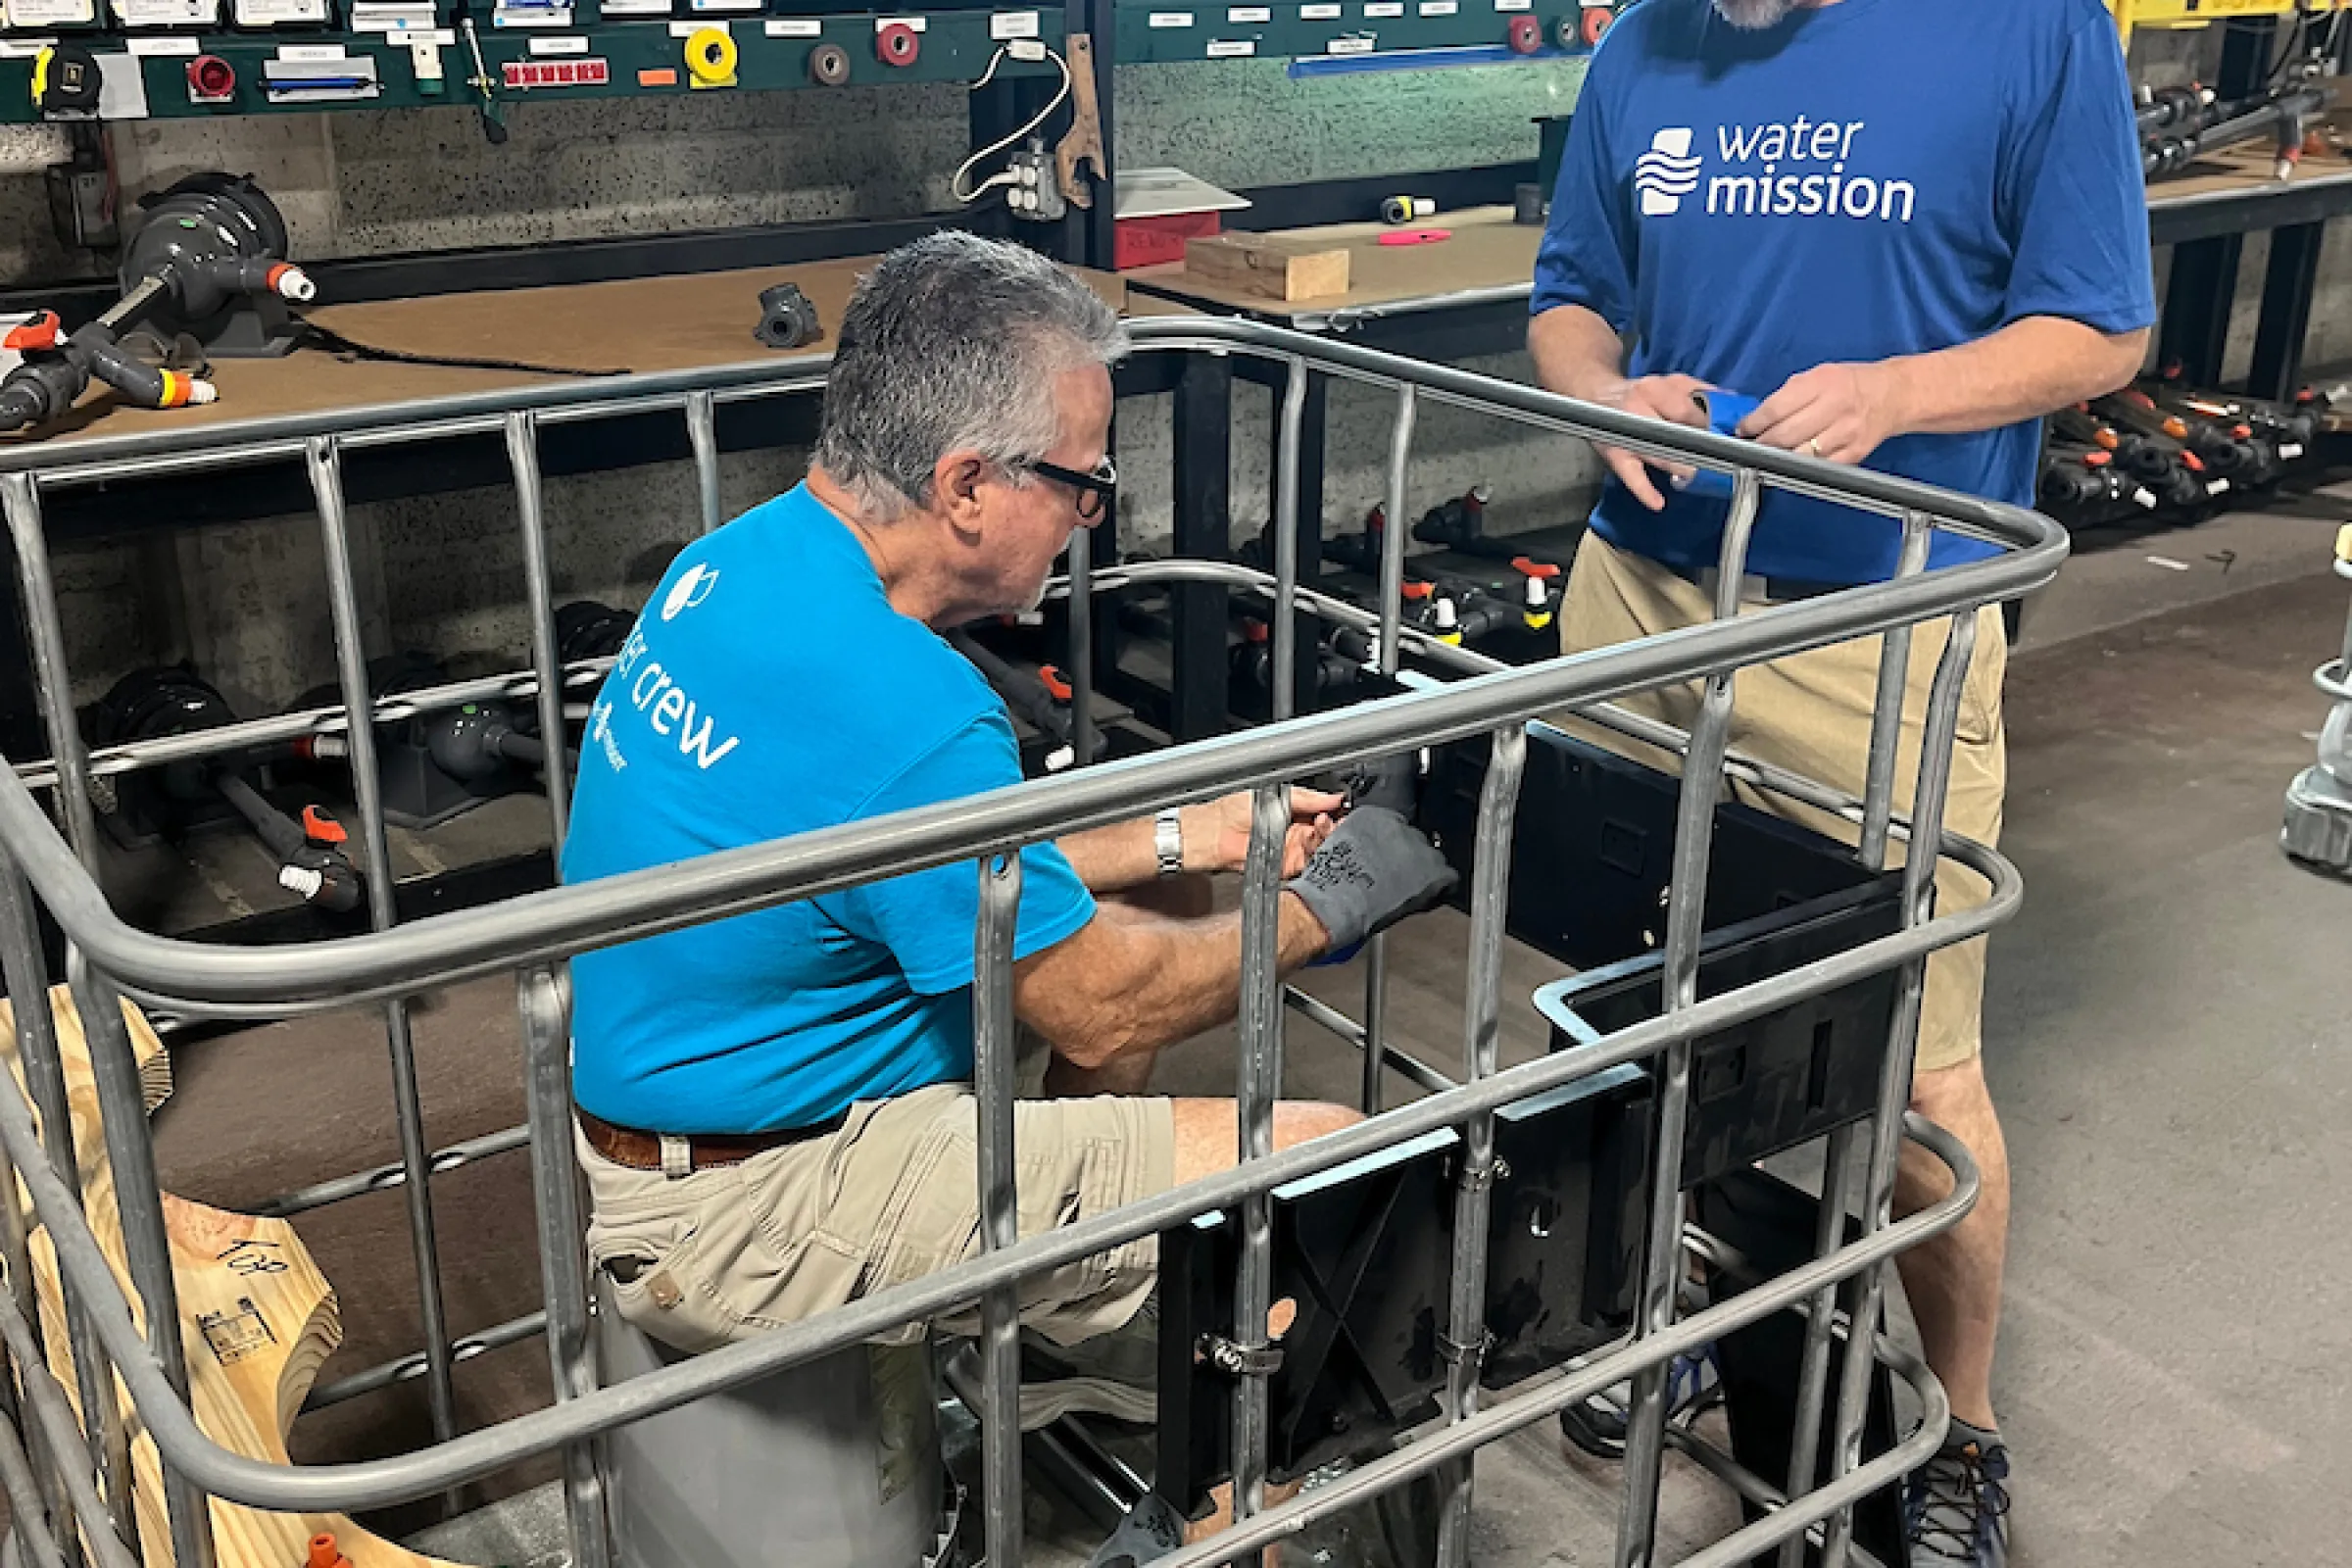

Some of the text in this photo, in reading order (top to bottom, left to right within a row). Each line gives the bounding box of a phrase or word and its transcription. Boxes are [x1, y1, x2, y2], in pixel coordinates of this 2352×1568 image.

[1719, 115, 1864, 162] water
[1706, 163, 1914, 220] mission
[632, 662, 740, 769] crew
